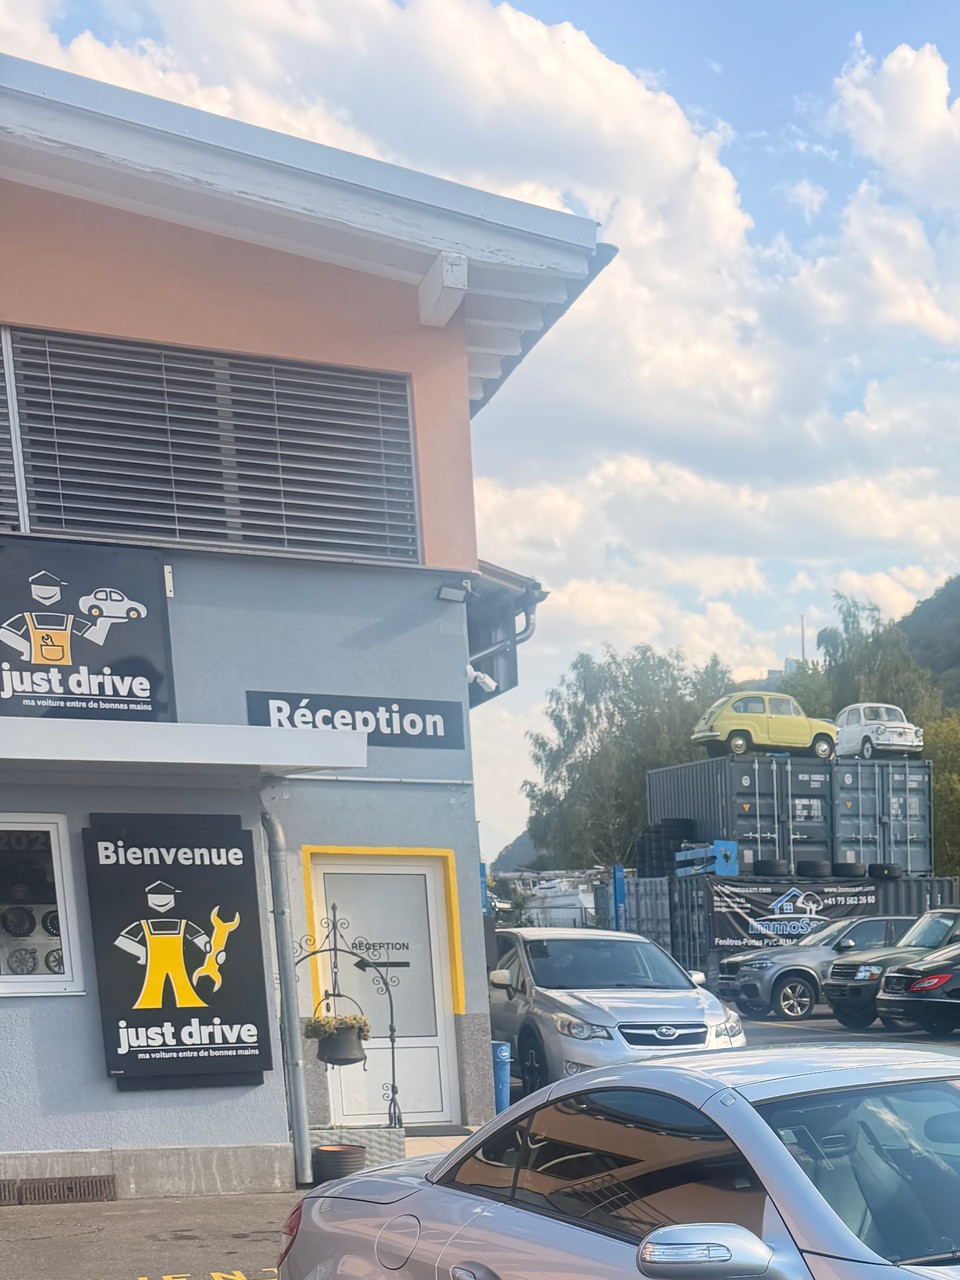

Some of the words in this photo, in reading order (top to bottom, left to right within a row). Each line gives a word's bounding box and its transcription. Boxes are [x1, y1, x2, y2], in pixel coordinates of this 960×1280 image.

[1, 662, 64, 699] just
[68, 666, 151, 698] drive
[36, 699, 65, 707] voiture
[66, 700, 87, 708] entre
[88, 700, 98, 709] de
[99, 701, 128, 710] bonnes
[129, 701, 152, 711] mains
[268, 698, 445, 737] Réception
[97, 840, 244, 866] Bienvenue
[117, 1020, 177, 1055] just
[180, 1017, 258, 1045] drive
[138, 1052, 150, 1060] ma
[150, 1050, 178, 1059] voiture
[178, 1050, 198, 1058] entre
[198, 1049, 209, 1057] de
[209, 1048, 237, 1057] bonnes
[237, 1047, 260, 1056] mains
